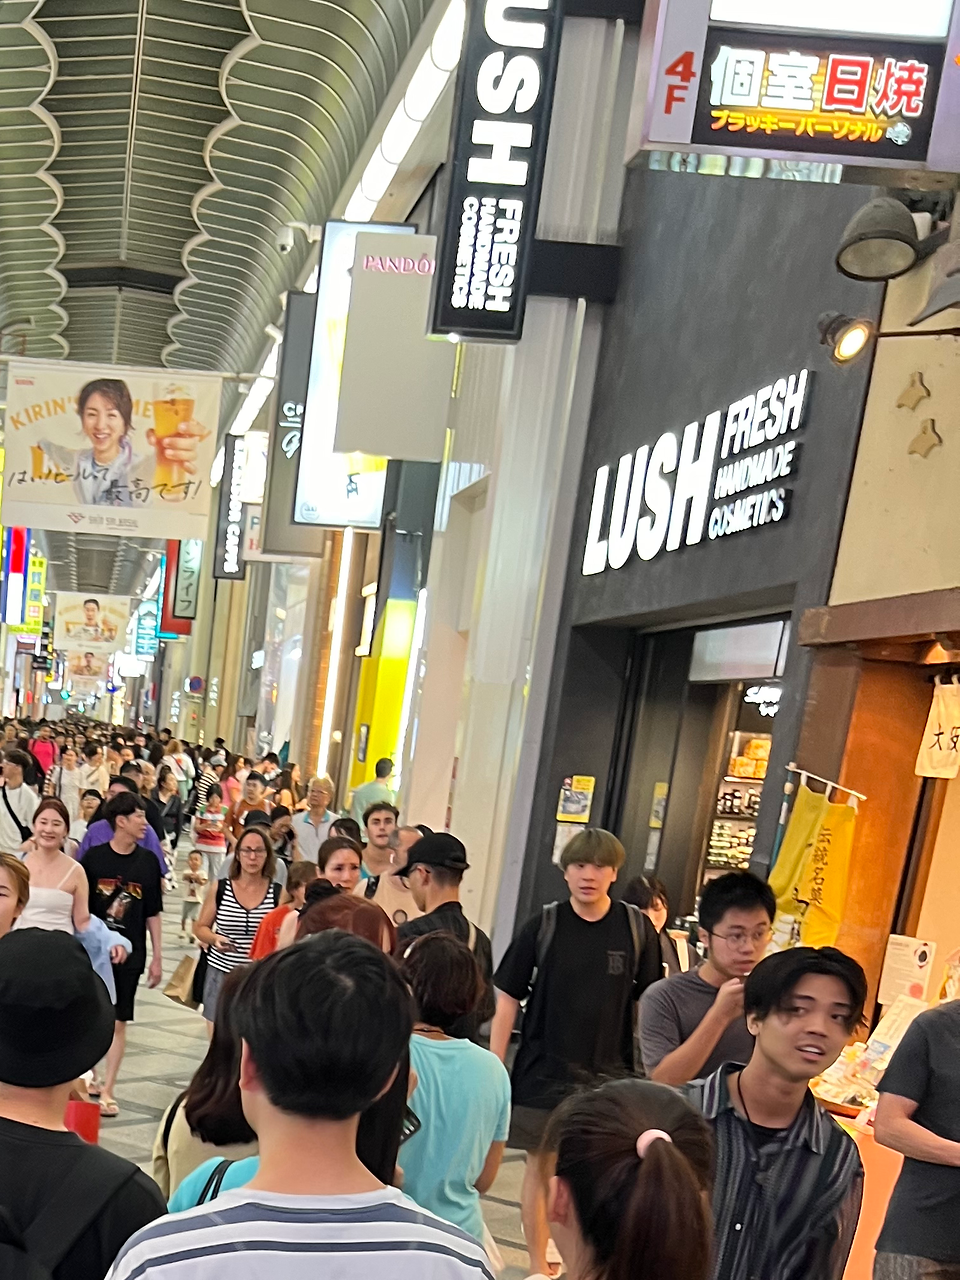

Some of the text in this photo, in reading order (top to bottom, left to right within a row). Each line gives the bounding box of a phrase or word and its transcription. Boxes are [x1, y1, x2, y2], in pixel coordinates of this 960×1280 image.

[709, 46, 929, 118] 個室日焼
[450, 195, 479, 310] COSMETICS
[467, 196, 497, 311] HANDMADE
[485, 198, 524, 313] FRESH
[720, 368, 809, 459] FRESH
[581, 409, 722, 576] LUSH
[708, 487, 786, 540] COSMETICS
[714, 440, 796, 500] HANDMADE
